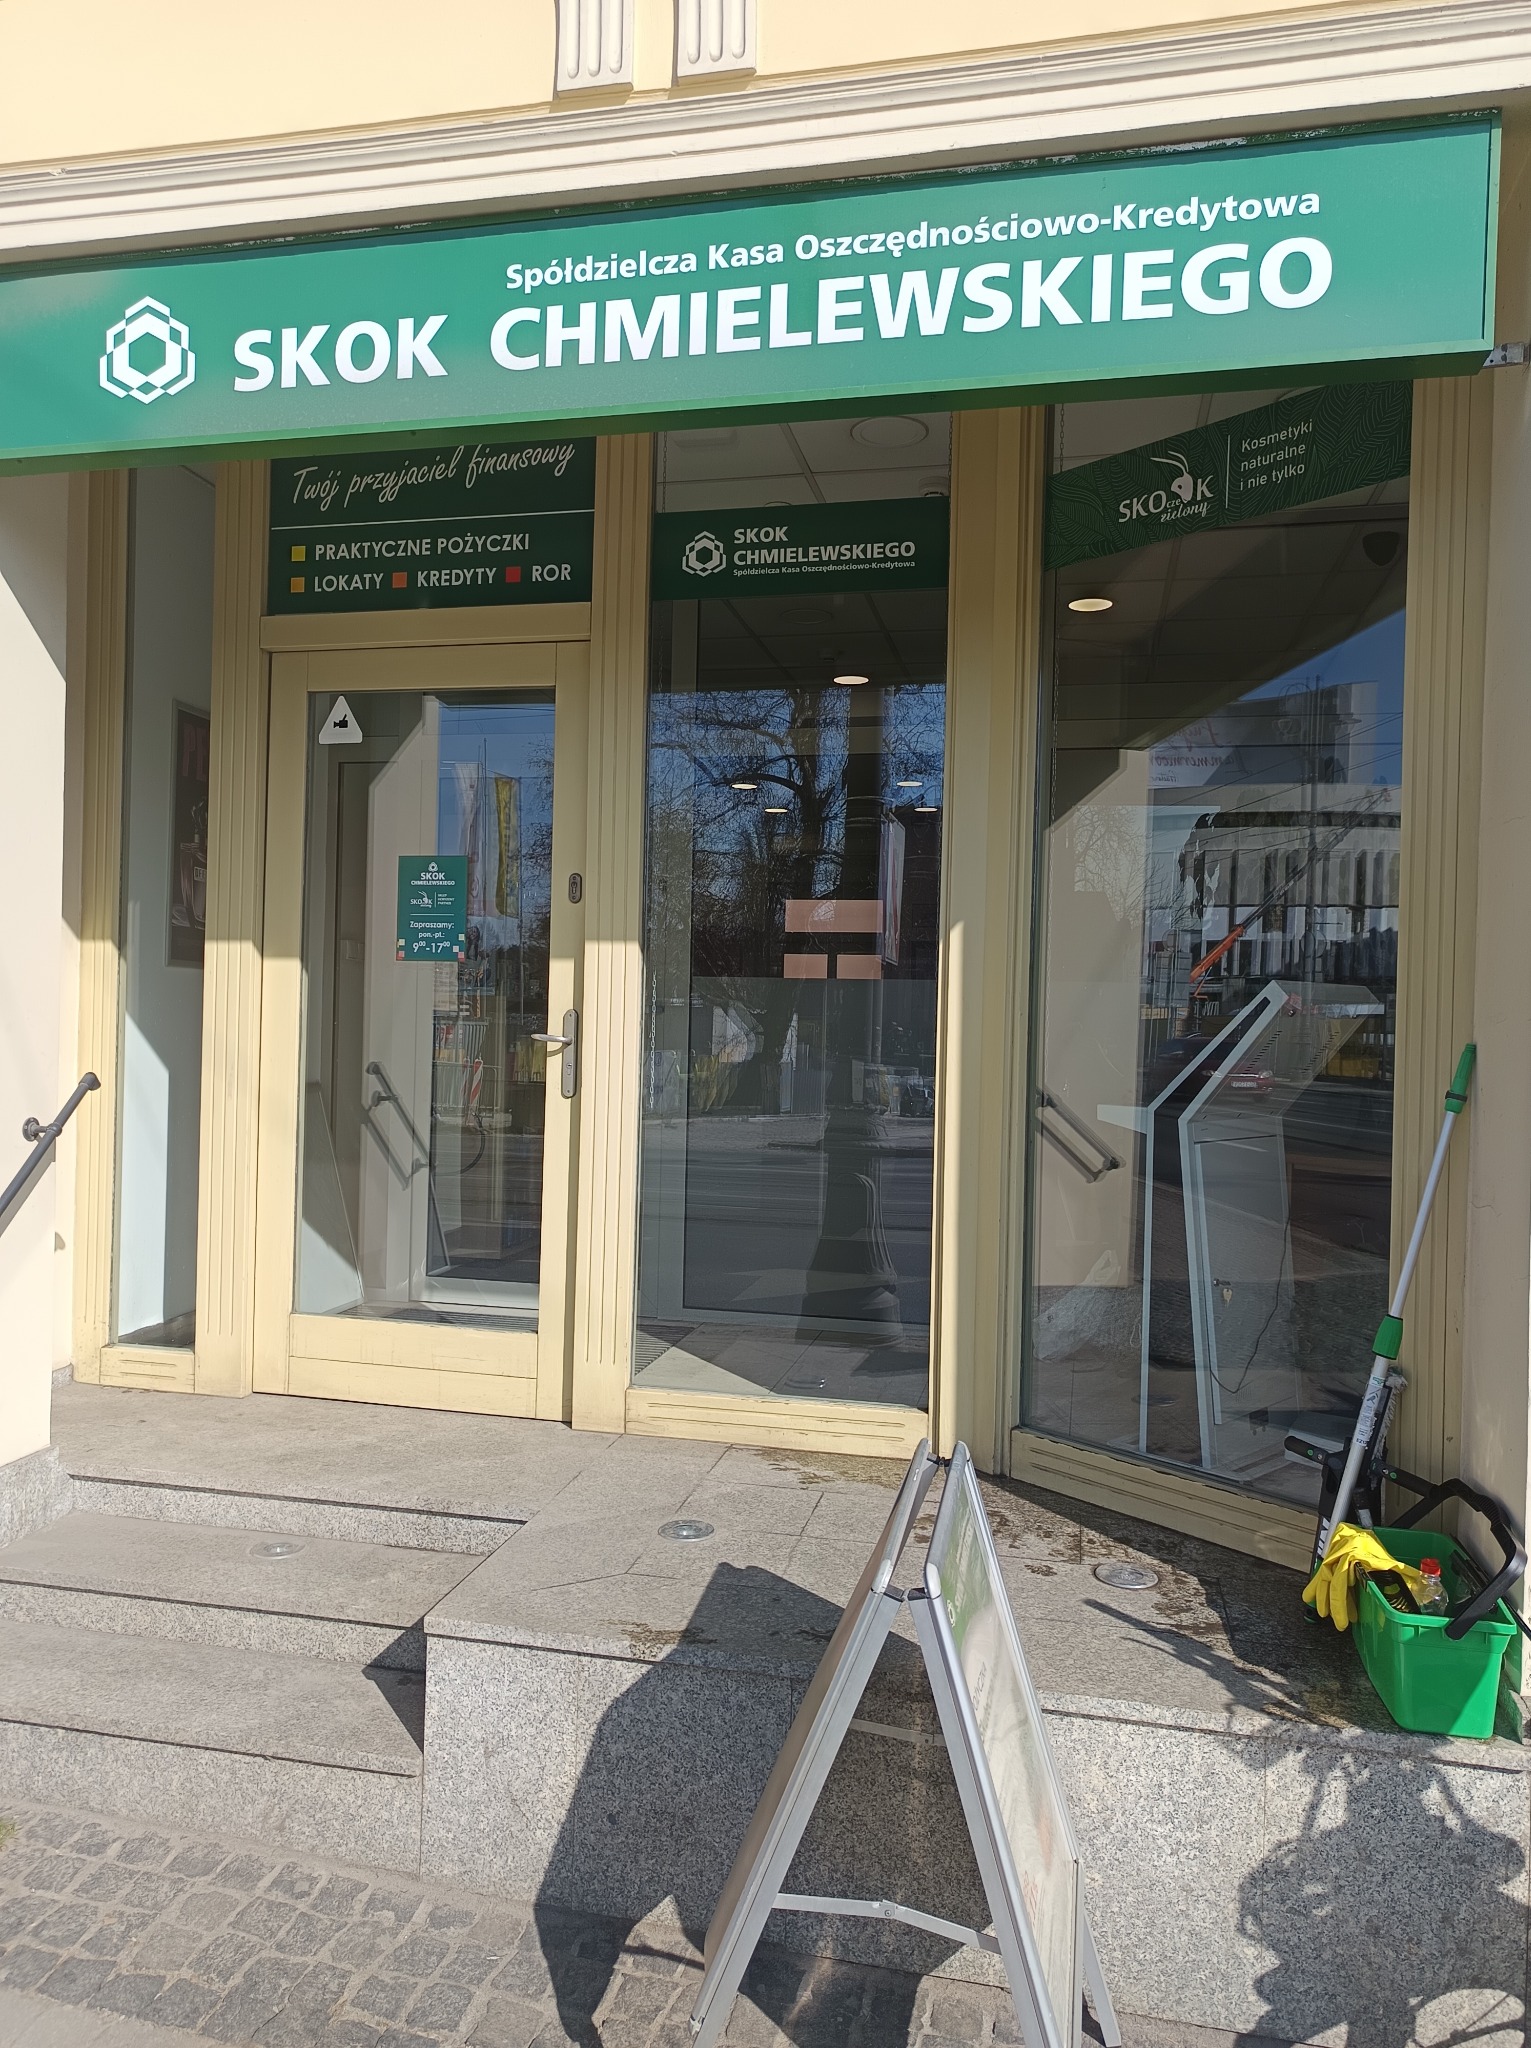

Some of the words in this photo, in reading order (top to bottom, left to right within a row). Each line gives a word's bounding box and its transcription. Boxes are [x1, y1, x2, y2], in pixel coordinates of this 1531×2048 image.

[505, 249, 698, 295] Spółdzielcza
[707, 242, 785, 270] Kasa
[794, 192, 1321, 260] Oszczędnościowo-Kredytowa
[232, 313, 450, 393] SKOK
[489, 236, 1334, 371] CHMIELEWSKIEGO
[1241, 418, 1313, 453] Kosmetyki
[1240, 443, 1306, 472] naturalne
[292, 466, 340, 512] Twój
[343, 444, 465, 509] przyjaciel
[465, 443, 576, 489] finansowy
[1247, 474, 1268, 489] nie
[1271, 464, 1305, 484] tylko
[314, 537, 432, 561] PRAKTYCZNE
[436, 531, 531, 555] POŻYCZKI
[733, 526, 789, 543] SKOK
[733, 541, 916, 566] CHMIELEWSKIEGO
[313, 572, 385, 593] LOKATY
[416, 566, 498, 588] KREDYTY
[531, 563, 572, 583] ROR
[733, 566, 780, 577] Spółdzielcza
[781, 566, 800, 574] Kasa
[801, 561, 916, 573] Oszczędnościowo-Kredytowa
[420, 872, 446, 881] SKOK
[409, 920, 455, 930] Zapraszamy:
